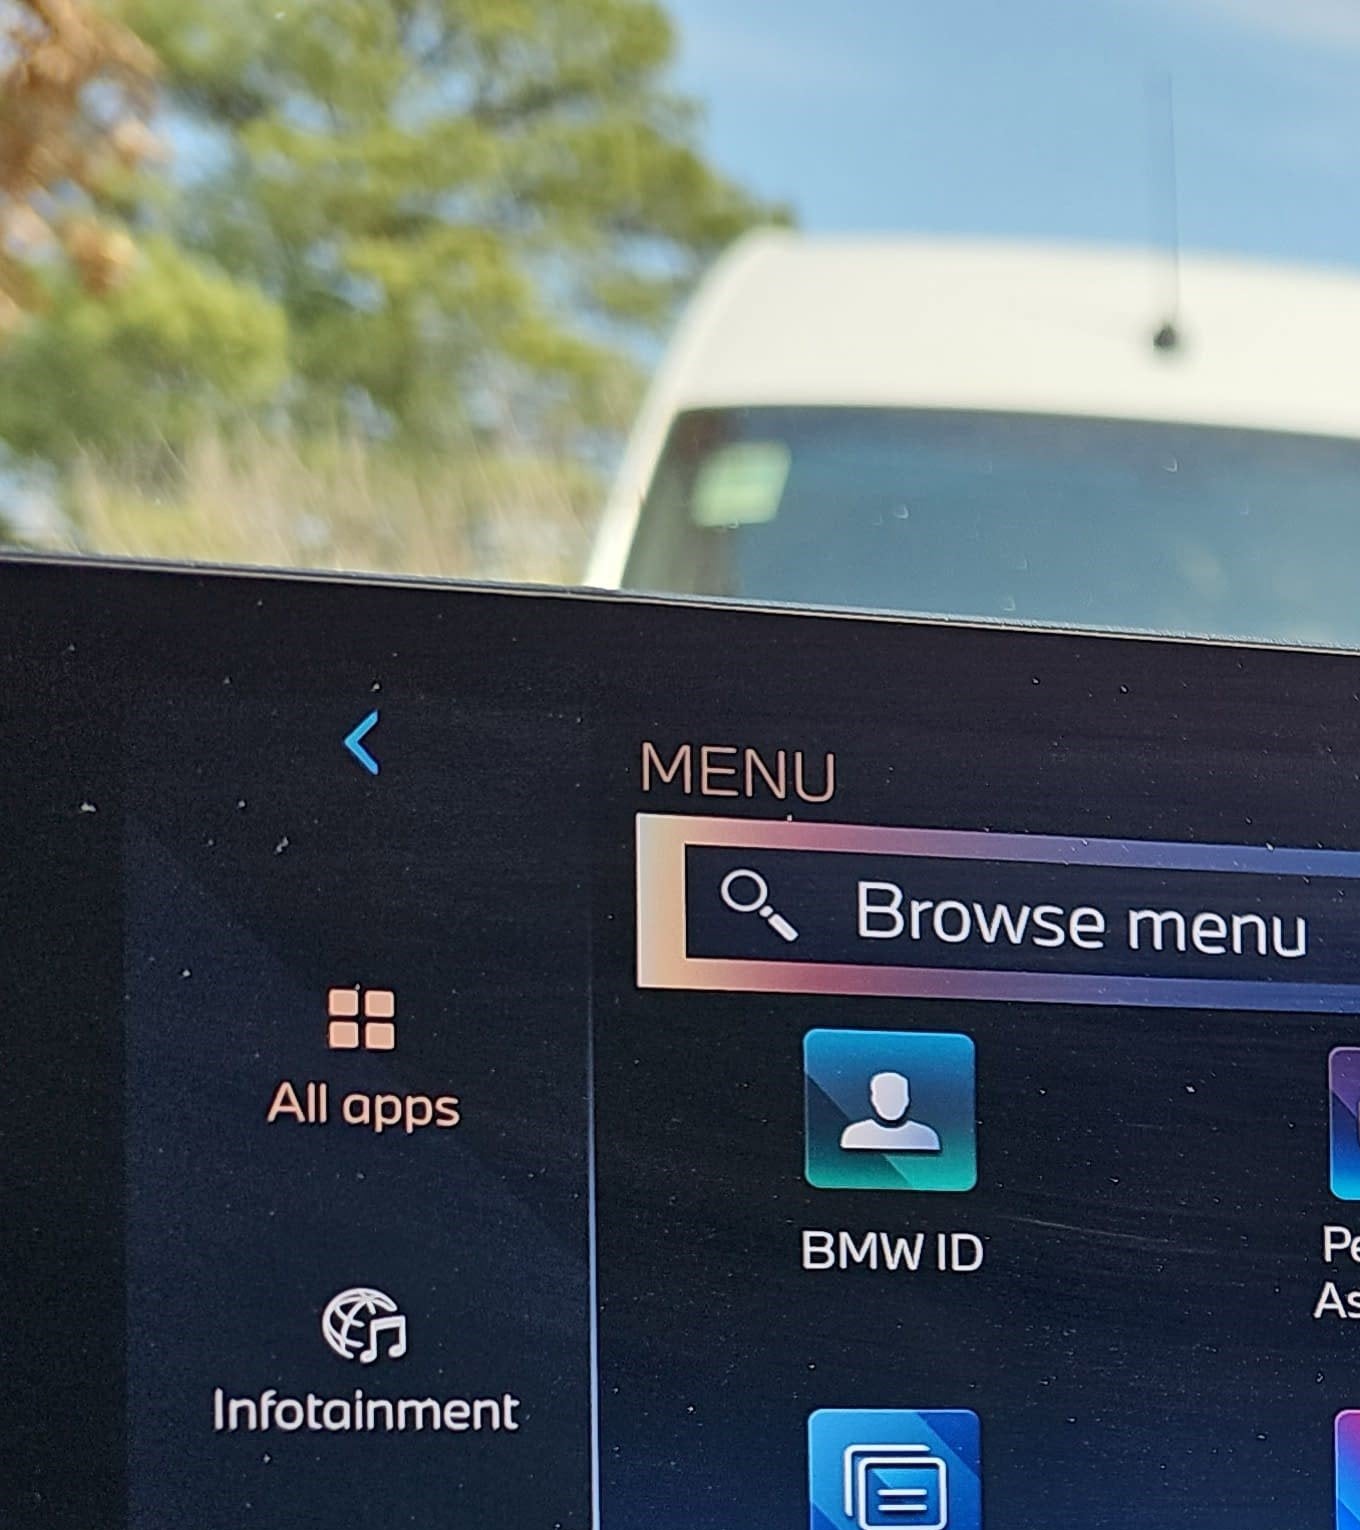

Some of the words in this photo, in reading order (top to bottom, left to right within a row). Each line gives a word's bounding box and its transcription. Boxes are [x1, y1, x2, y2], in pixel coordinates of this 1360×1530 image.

[638, 741, 836, 803] MENU
[856, 880, 1106, 950] Browse
[1127, 907, 1308, 958] menu
[266, 1081, 328, 1124] All
[342, 1093, 461, 1135] apps
[802, 1229, 925, 1272] BMW
[937, 1232, 985, 1272] ID
[213, 1387, 521, 1431] Infotainment
